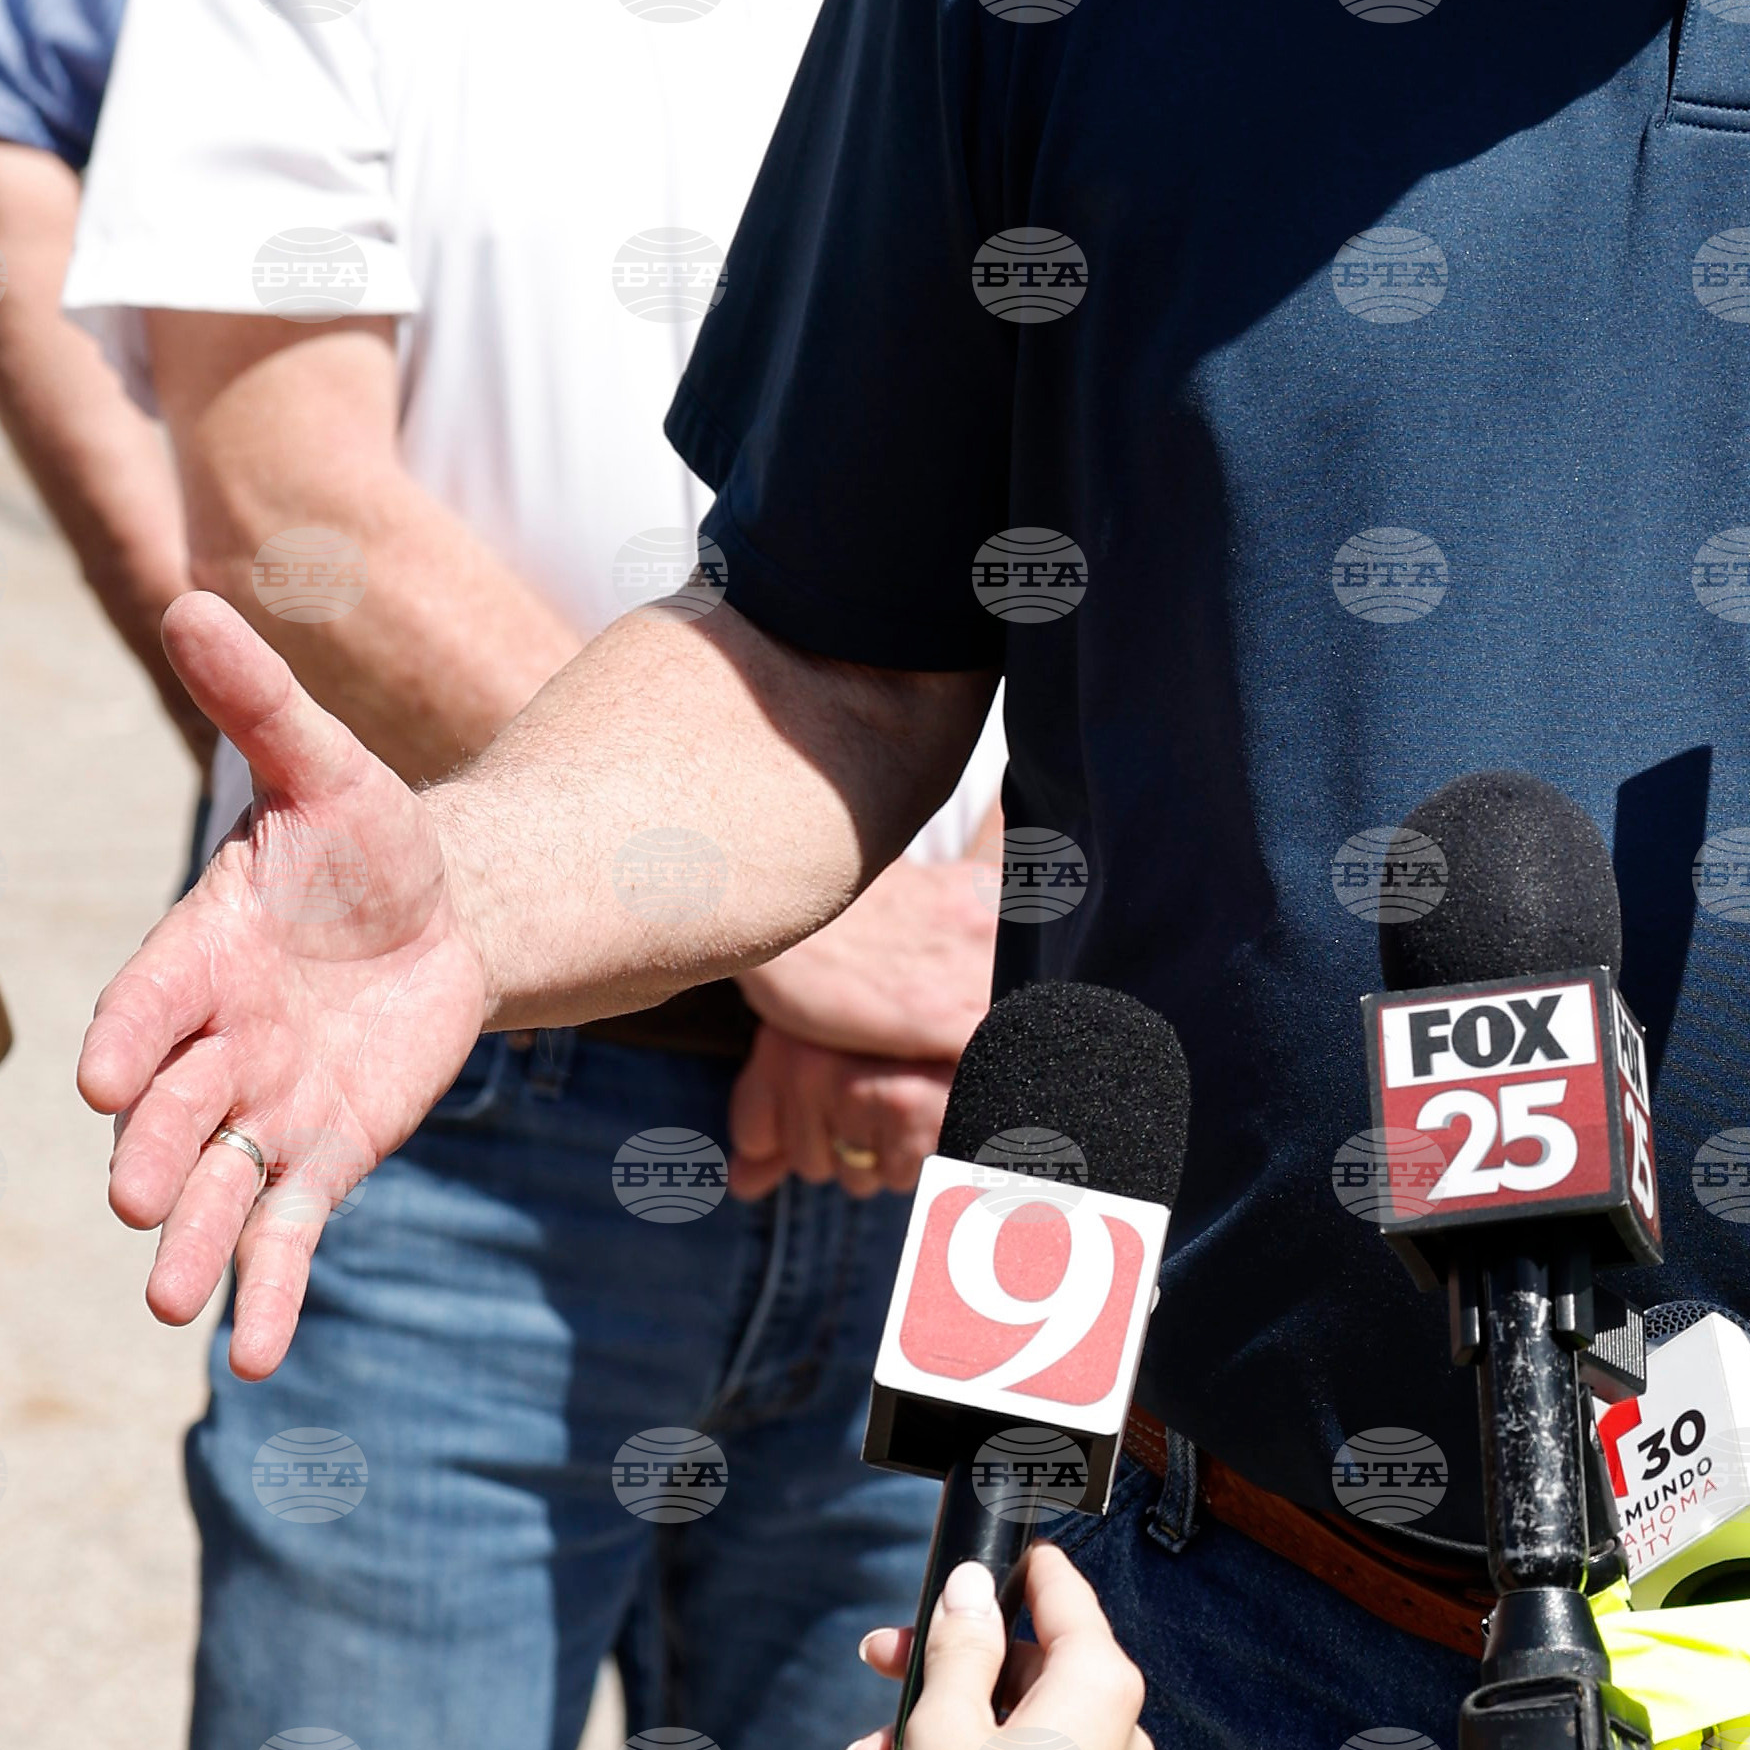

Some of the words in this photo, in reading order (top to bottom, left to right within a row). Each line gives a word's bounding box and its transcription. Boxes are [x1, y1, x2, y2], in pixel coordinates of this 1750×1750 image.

[1408, 993, 1569, 1078] FOX
[1415, 1078, 1578, 1201] 25
[947, 1177, 1115, 1391] 9
[1637, 1408, 1706, 1481] 30
